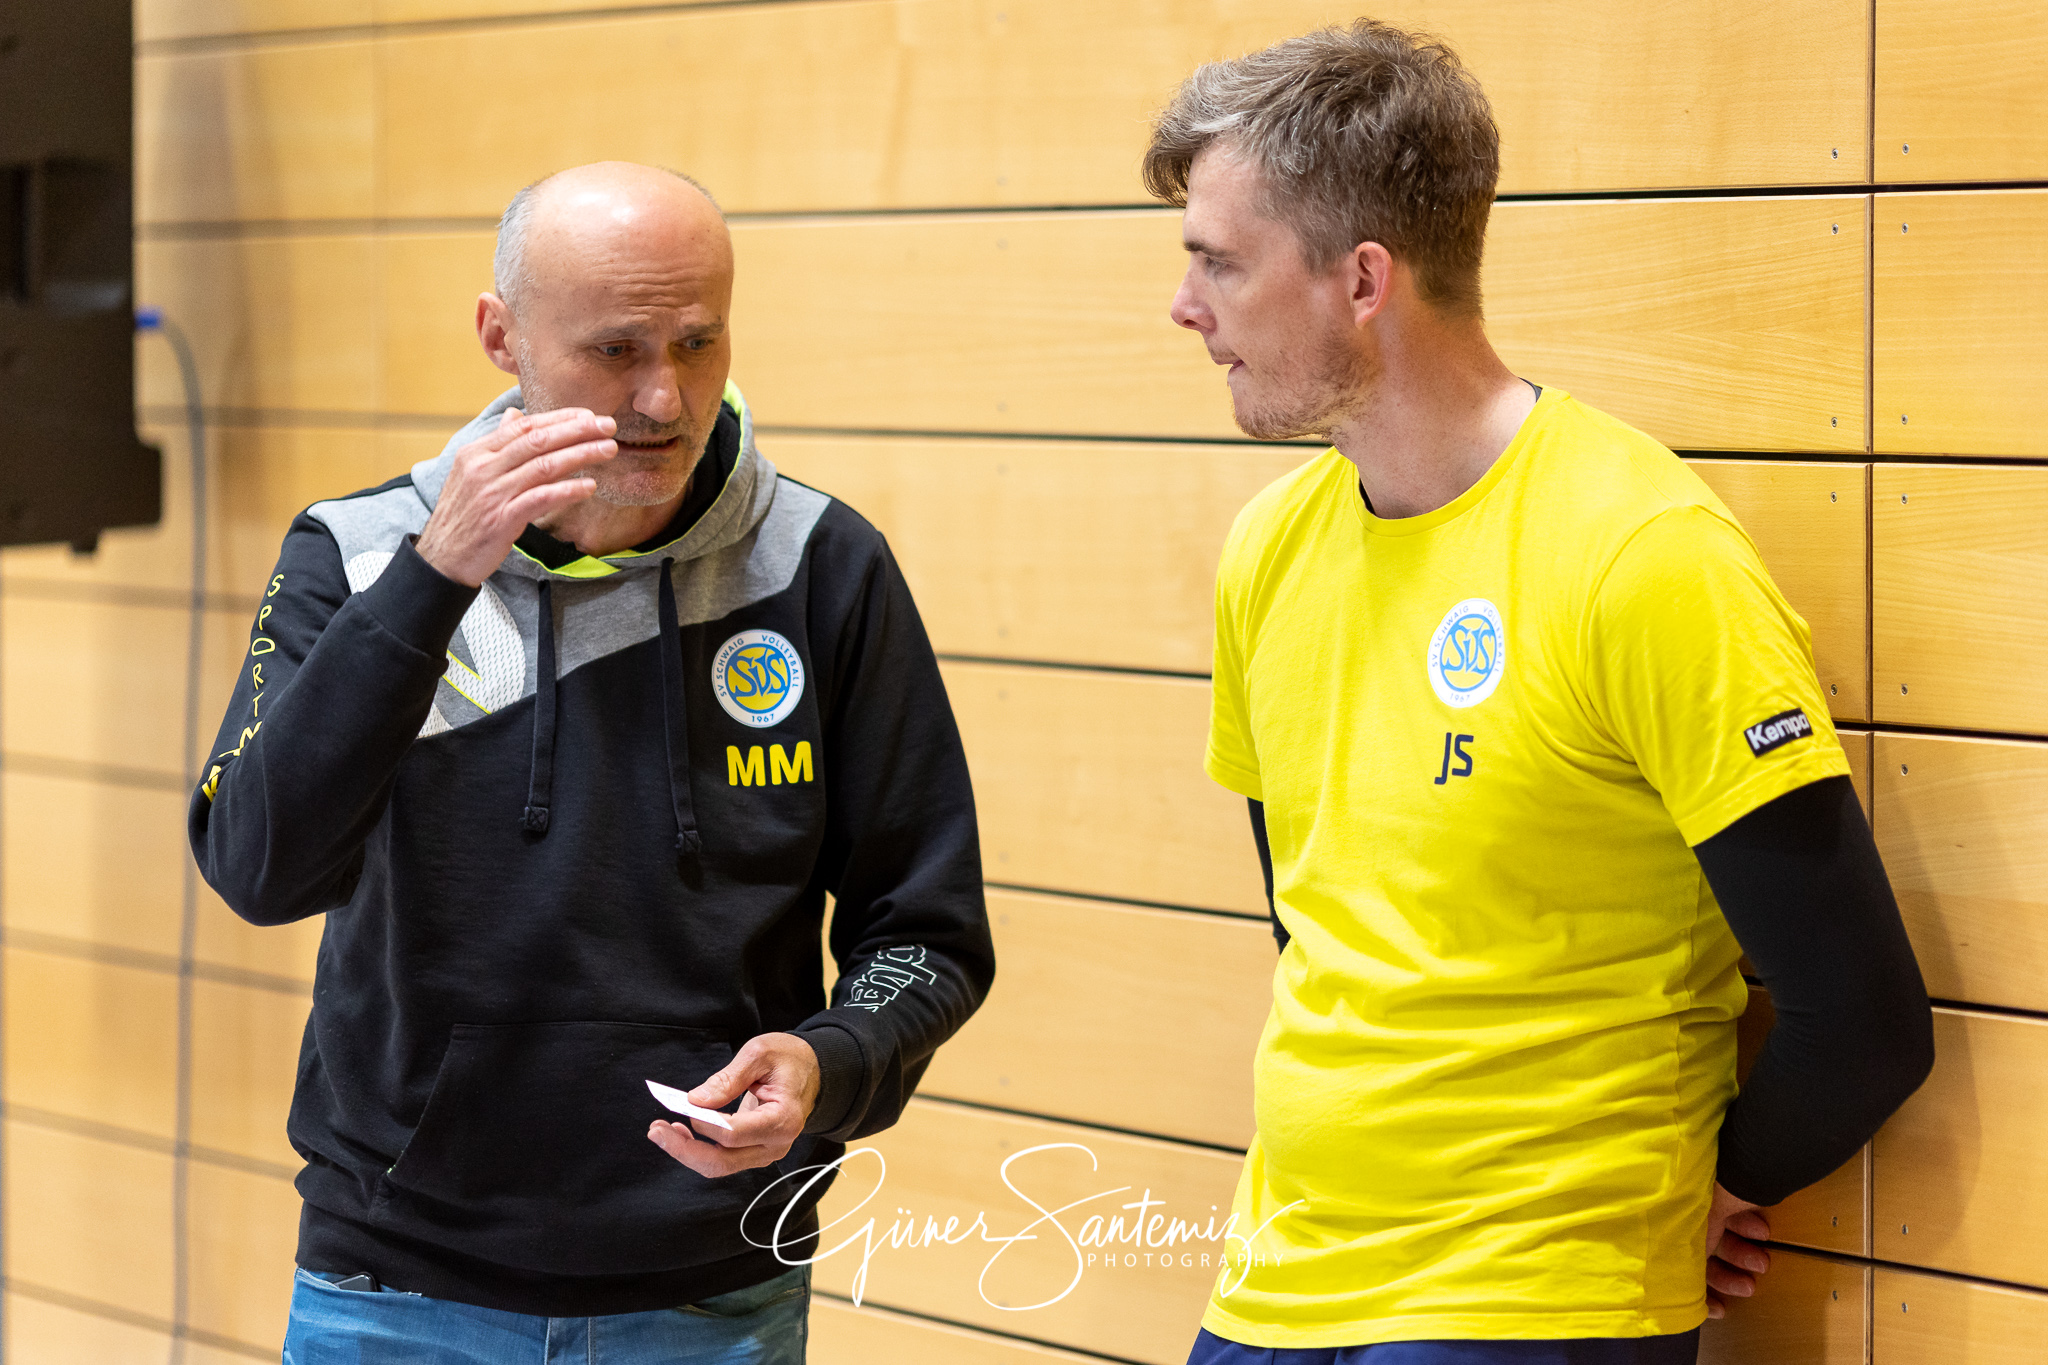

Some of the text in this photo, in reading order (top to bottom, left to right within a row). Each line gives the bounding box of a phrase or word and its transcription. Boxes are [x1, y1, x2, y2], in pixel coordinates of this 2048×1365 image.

[1434, 605, 1470, 648] SCHWAIG
[1483, 605, 1504, 673] VOLLEYBALL
[1442, 621, 1495, 675] SVS
[716, 634, 800, 697] SV SCHWAIG VOLLEYBALL
[728, 647, 786, 697] SVS
[751, 713, 775, 723] 1967
[1449, 692, 1471, 703] 1967
[1746, 713, 1810, 750] Kempa
[726, 740, 814, 787] MM
[1434, 732, 1474, 785] JS
